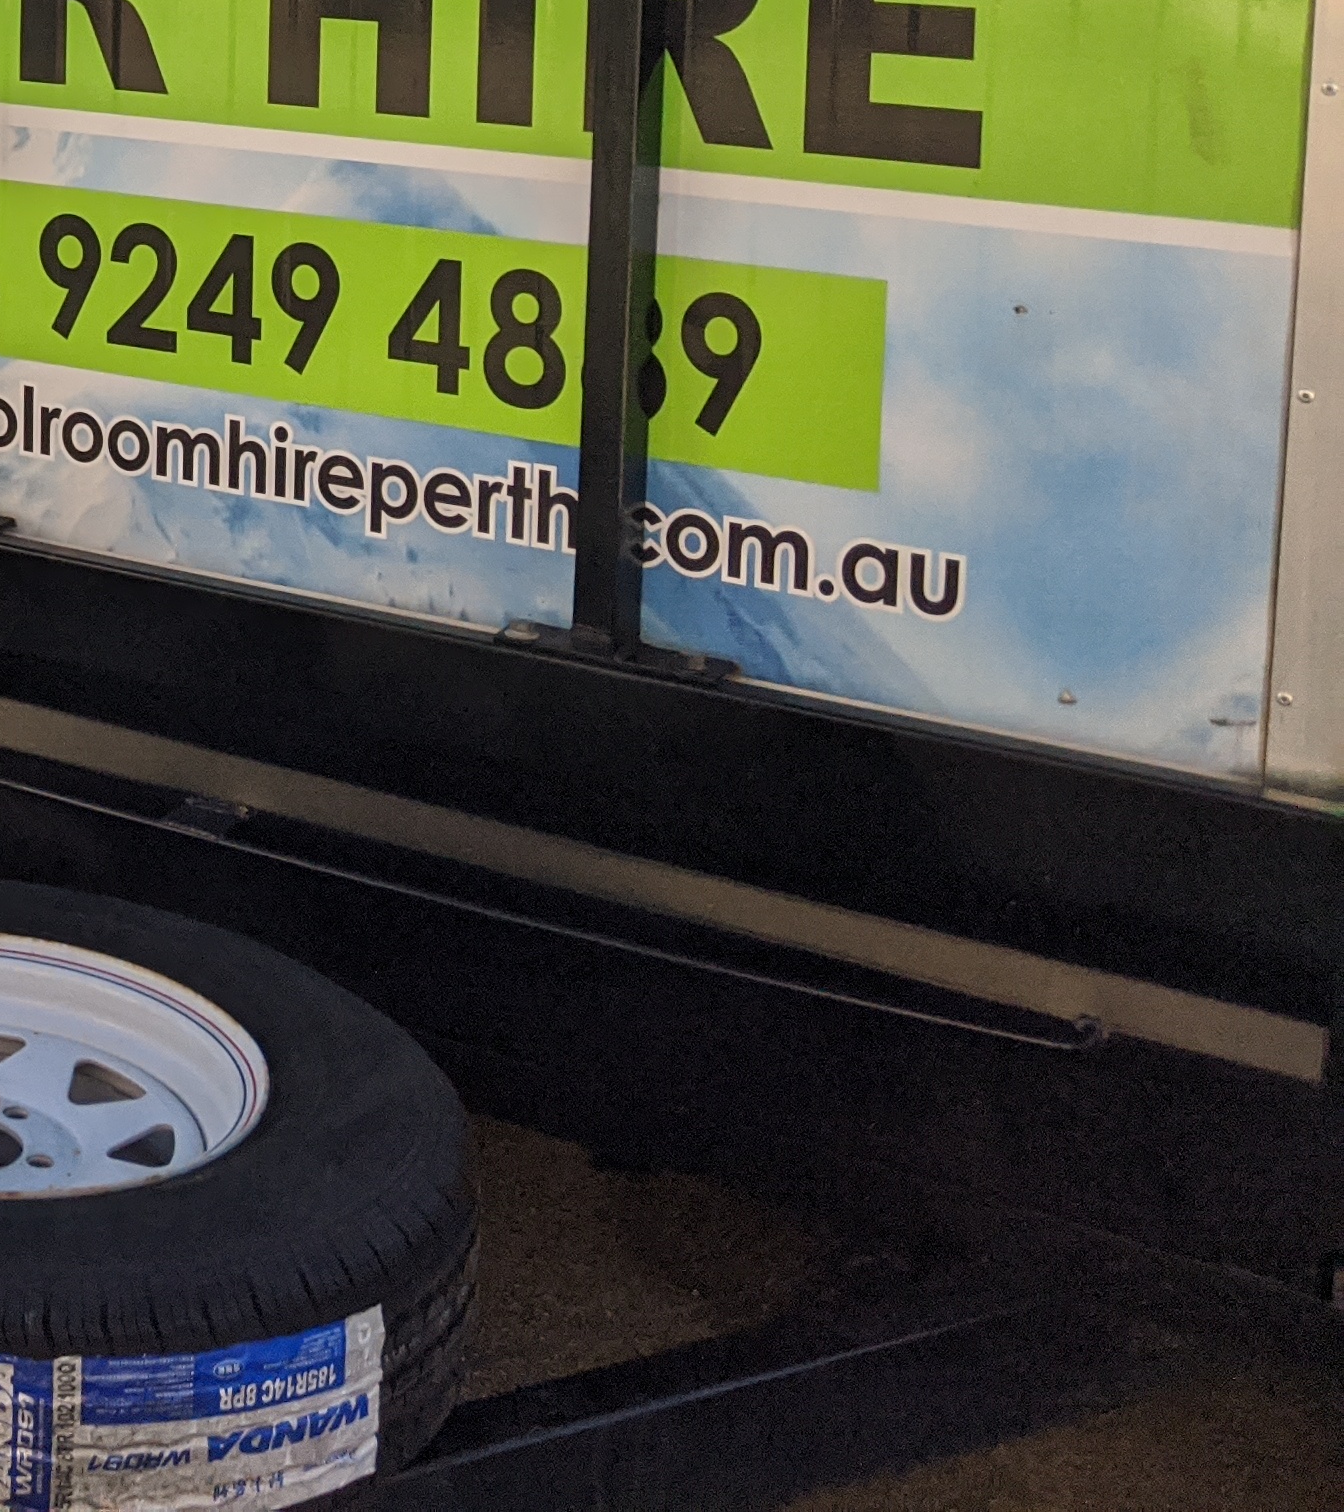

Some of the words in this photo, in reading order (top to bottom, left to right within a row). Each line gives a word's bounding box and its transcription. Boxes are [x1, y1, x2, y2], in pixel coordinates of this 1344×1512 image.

[38, 213, 340, 377] 9249
[218, 1383, 258, 1410] 8PR
[261, 1363, 338, 1403] 185R14C
[207, 1391, 370, 1463] WANDA
